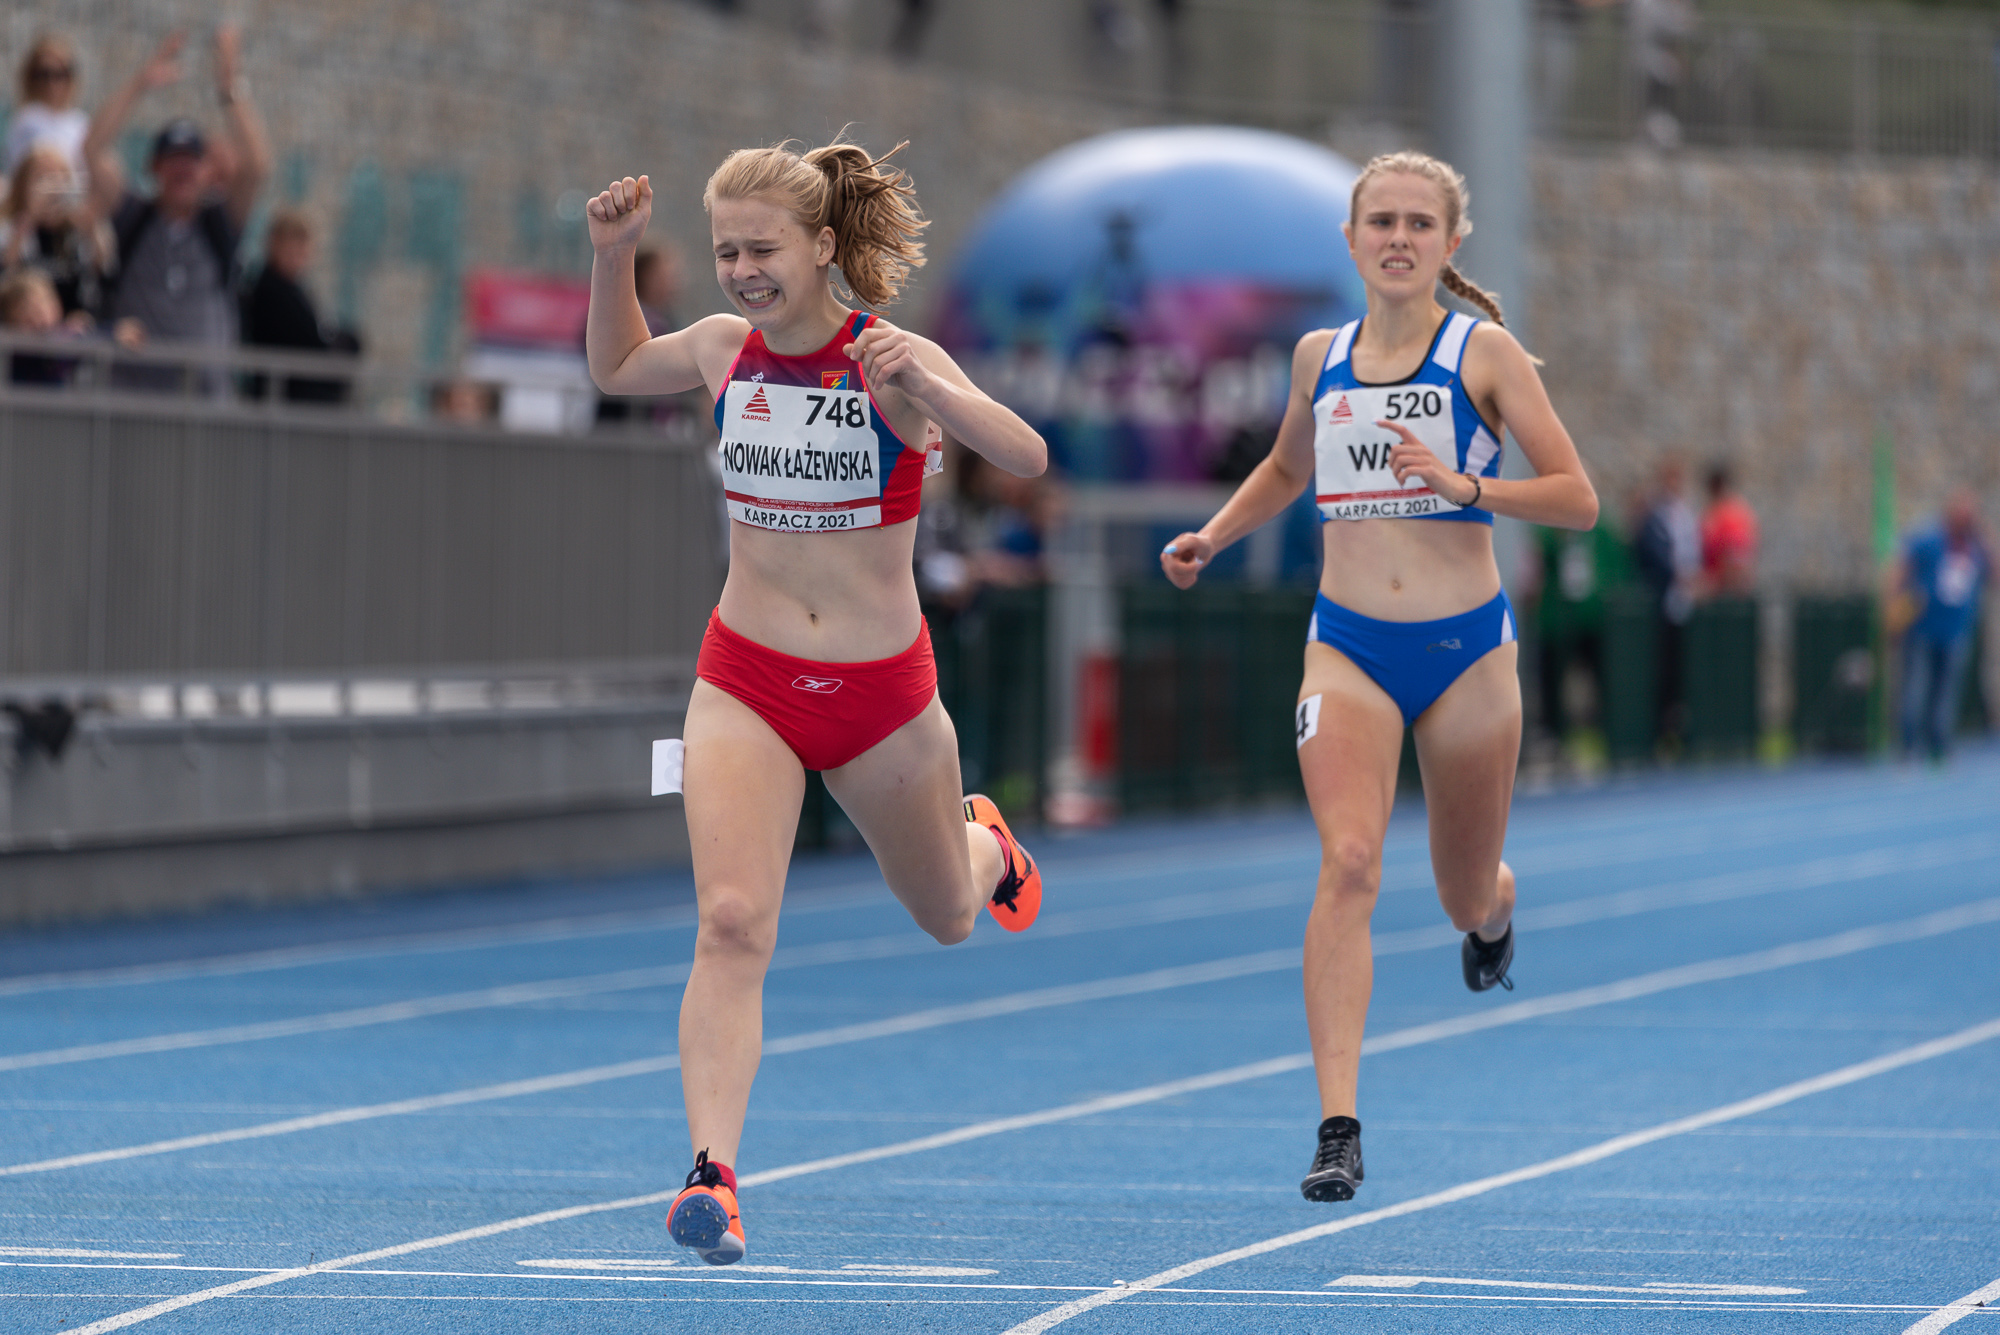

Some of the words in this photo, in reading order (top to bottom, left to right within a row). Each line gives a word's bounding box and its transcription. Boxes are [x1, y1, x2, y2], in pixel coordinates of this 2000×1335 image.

[741, 413, 771, 422] KARPACZ
[805, 394, 866, 428] 748
[1385, 391, 1441, 419] 520
[724, 441, 782, 478] NOWAK
[784, 441, 873, 481] ŁAŻEWSKA
[1347, 441, 1403, 472] WA
[744, 507, 813, 529] KARPACZ
[817, 513, 855, 528] 2021
[1335, 502, 1400, 518] KARPACZ
[1403, 498, 1438, 514] 2021
